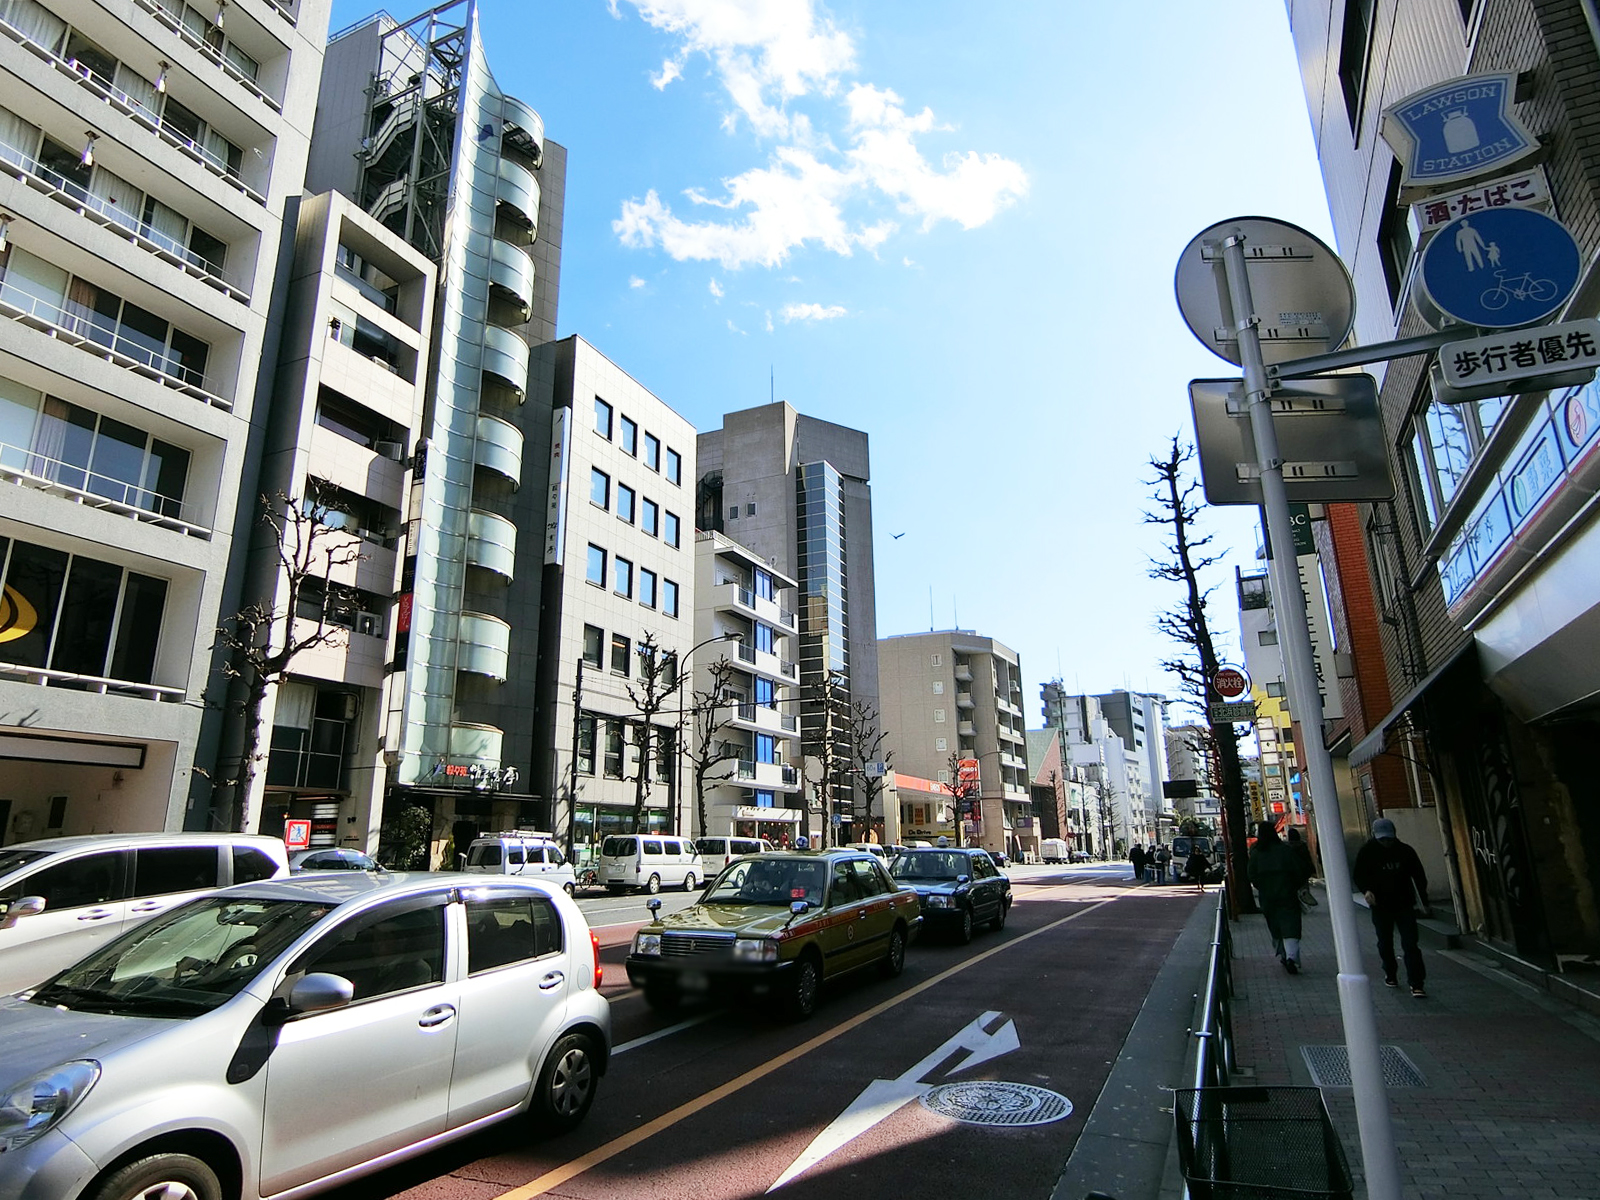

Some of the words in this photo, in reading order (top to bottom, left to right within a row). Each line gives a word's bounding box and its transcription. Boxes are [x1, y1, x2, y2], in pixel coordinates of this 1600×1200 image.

[1406, 84, 1497, 122] LAWSON
[1422, 137, 1511, 172] STATION
[1453, 331, 1597, 378] 歩行者優先
[1215, 676, 1244, 689] 消火栓
